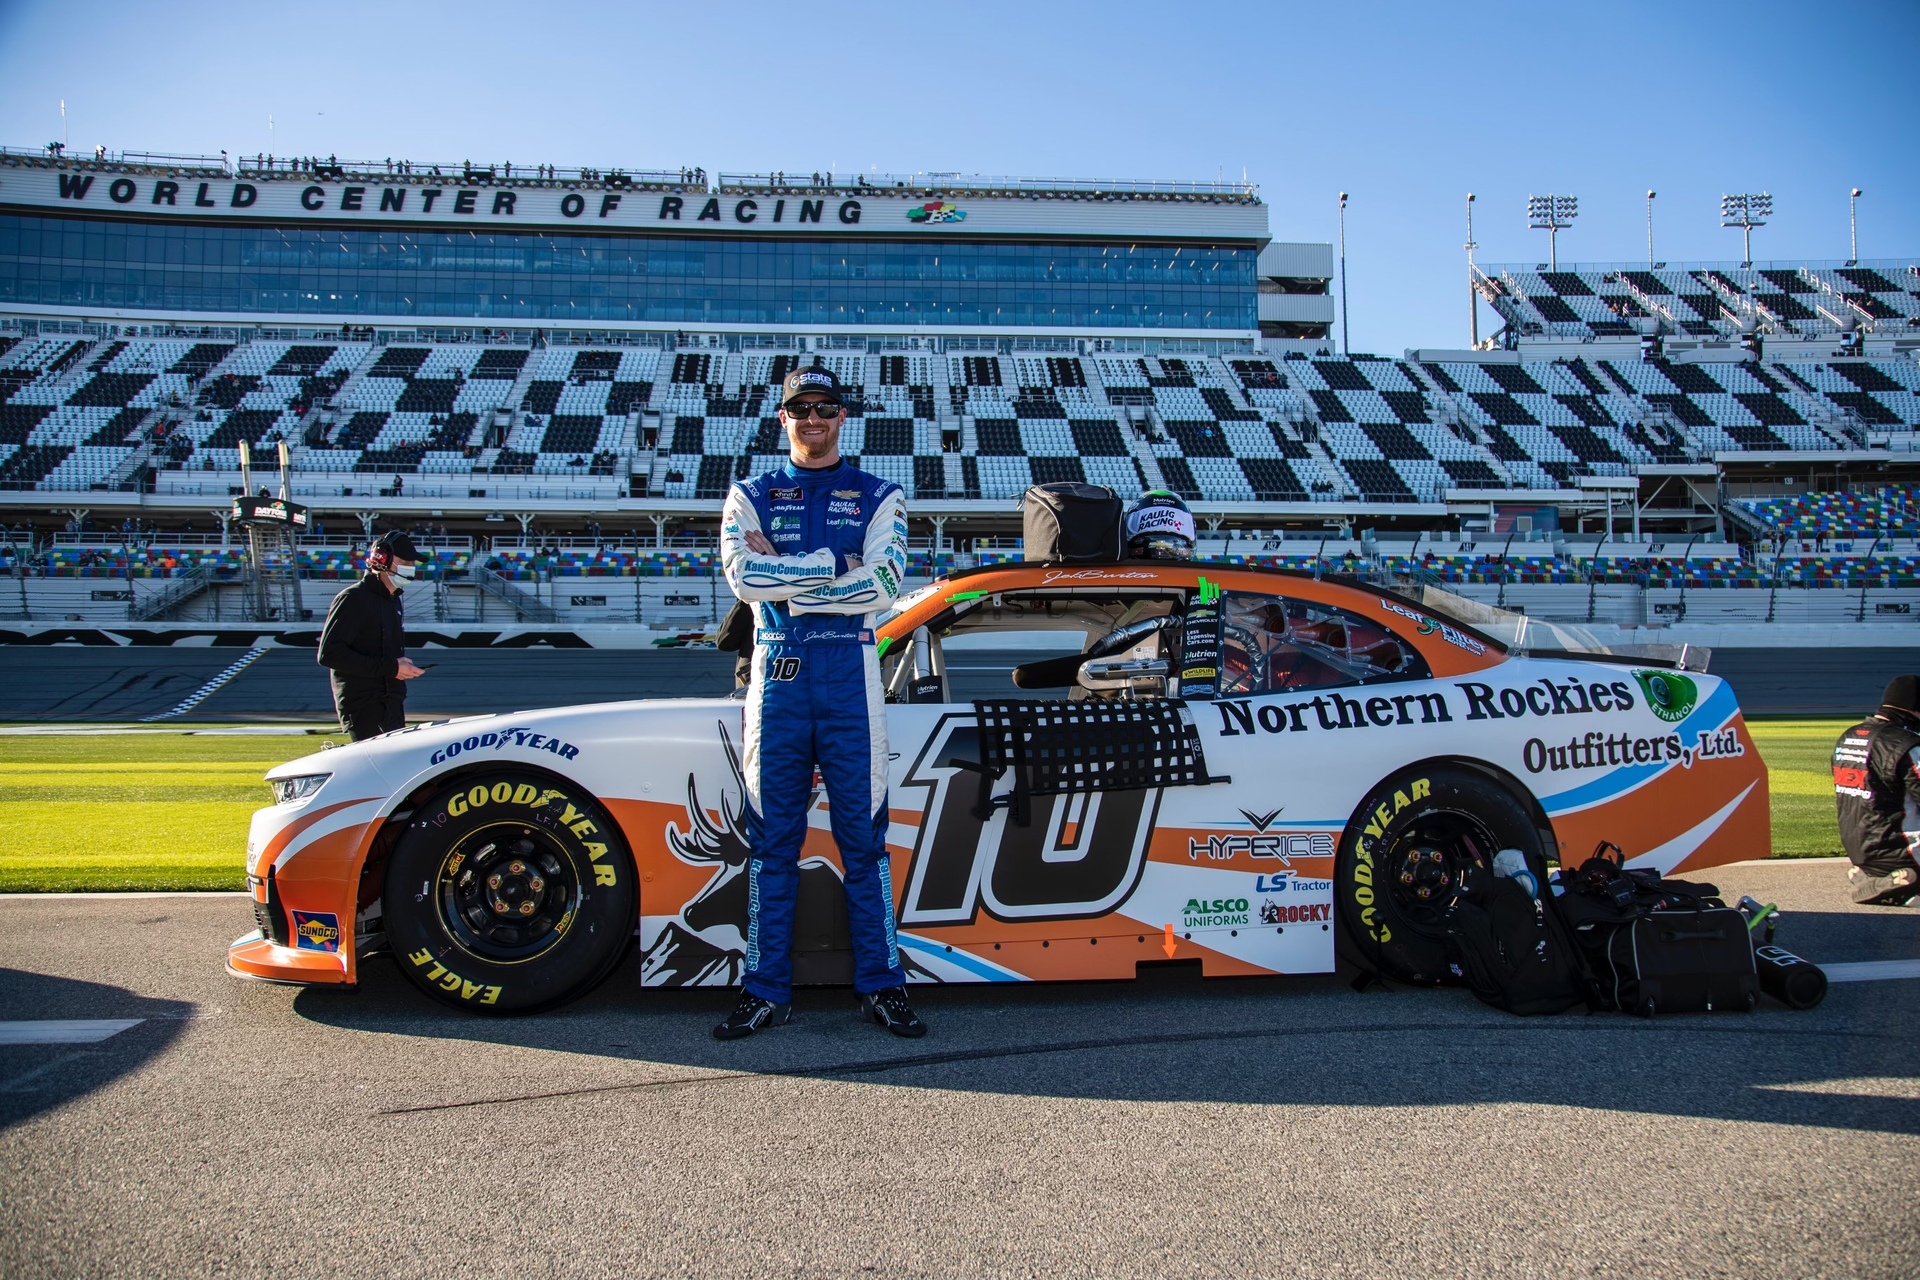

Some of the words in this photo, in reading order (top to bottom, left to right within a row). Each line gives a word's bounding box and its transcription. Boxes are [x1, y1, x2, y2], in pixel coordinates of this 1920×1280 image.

[59, 174, 257, 208] WORLD
[301, 186, 517, 215] CENTER
[560, 193, 622, 218] OF
[659, 196, 862, 224] RACING
[800, 372, 832, 382] state
[1138, 518, 1174, 532] RACING
[1140, 510, 1176, 523] KAULIG
[744, 560, 833, 576] KauligCompanies
[803, 578, 875, 597] igCompanies
[1380, 598, 1424, 623] Leaf
[1440, 623, 1487, 653] Filter
[1187, 633, 1216, 641] Expensive
[1187, 638, 1214, 646] Cars.com
[1185, 650, 1217, 659] Nutrien
[771, 657, 801, 681] 10
[1210, 693, 1453, 737] Northern
[1454, 676, 1635, 720] Rockies
[1651, 702, 1693, 721] ETHANOL
[430, 728, 580, 765] GOODYEAR
[1523, 732, 1691, 773] Outfitters,
[1699, 731, 1742, 757] Ltd.
[897, 713, 1167, 929] 10
[447, 782, 617, 887] GOODYEAR
[1190, 835, 1334, 867] HYPERICE
[1256, 873, 1289, 893] LS
[1291, 880, 1331, 892] Tractor
[748, 859, 763, 971] KauligCompanies
[877, 856, 898, 969] KauligCompanies
[1183, 898, 1249, 914] ALSCO
[1278, 903, 1331, 924] ROCKY
[1184, 914, 1249, 927] UNIFORMS
[299, 925, 337, 939] SUNOCO
[408, 948, 503, 1005] EAGLE
